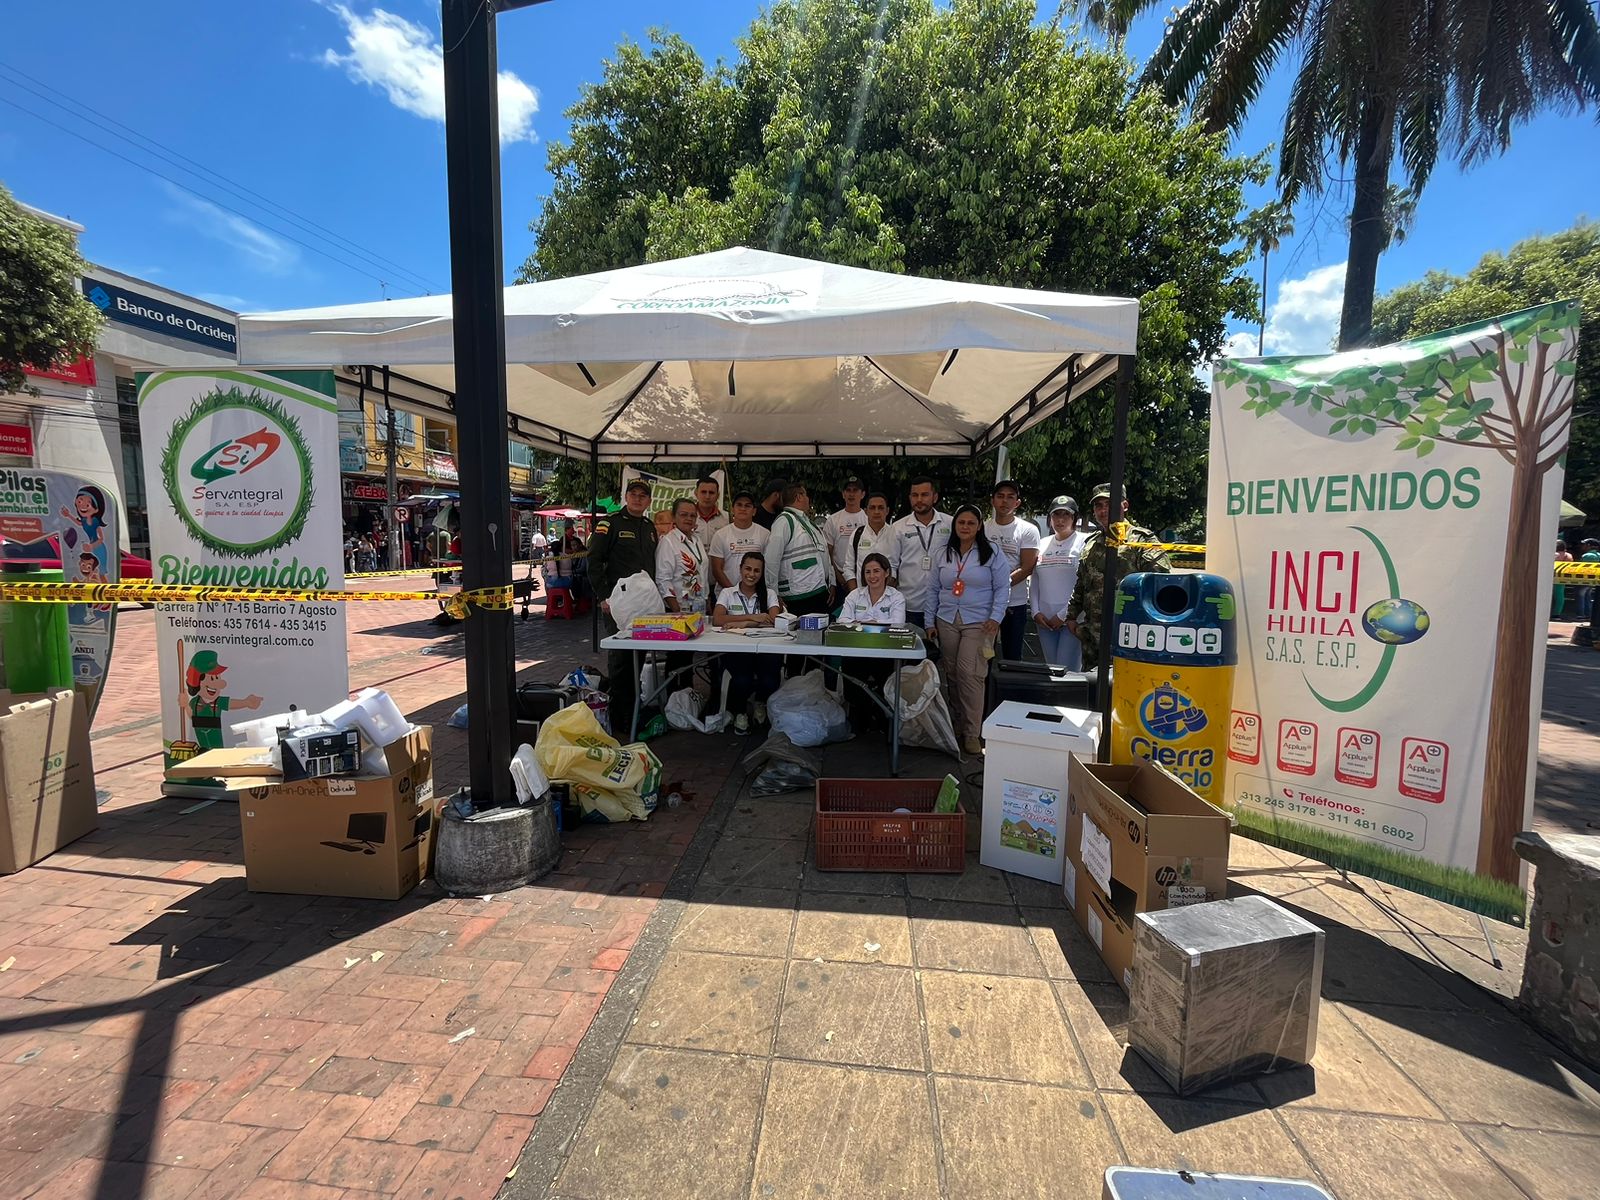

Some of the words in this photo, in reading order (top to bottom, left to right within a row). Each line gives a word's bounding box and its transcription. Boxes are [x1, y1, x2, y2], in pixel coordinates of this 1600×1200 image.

[617, 297, 790, 309] CORPOAMAZONIA
[116, 297, 164, 321] Banco
[166, 313, 184, 328] de
[186, 319, 235, 343] Occiden
[32, 491, 47, 504] el
[192, 486, 283, 503] Servintegral
[1226, 467, 1481, 516] BIENVENIDOS
[158, 554, 329, 590] Bienvenidos
[1268, 550, 1360, 614] INCI
[486, 595, 503, 603] NO
[157, 602, 194, 613] Carrera
[197, 602, 203, 613] 7
[223, 603, 250, 614] 17-15
[254, 603, 287, 615] Barrio
[289, 604, 296, 615] 7
[299, 604, 337, 618] Agosto
[168, 616, 221, 629] Teléfonos:
[223, 619, 242, 629] 435
[245, 619, 271, 630] 7614
[280, 619, 299, 631] 435
[302, 620, 327, 631] 3415
[1267, 614, 1355, 637] HUILA
[74, 646, 95, 654] ANDI
[184, 633, 314, 647] www.servintegral.com.co
[1266, 637, 1306, 664] S.A.S.
[1316, 641, 1360, 669] E.S.P.
[1131, 736, 1214, 767] Cierra
[1174, 767, 1212, 788] iclo
[271, 785, 316, 797] All-in-One
[1298, 791, 1365, 815] Teléfonos:
[1241, 791, 1261, 803] 313
[1264, 797, 1285, 809] 245
[1287, 802, 1316, 817] 3178
[1328, 812, 1347, 825] 311
[1354, 818, 1377, 831] 481
[1381, 824, 1414, 842] 6802
[1155, 866, 1177, 887] hp
